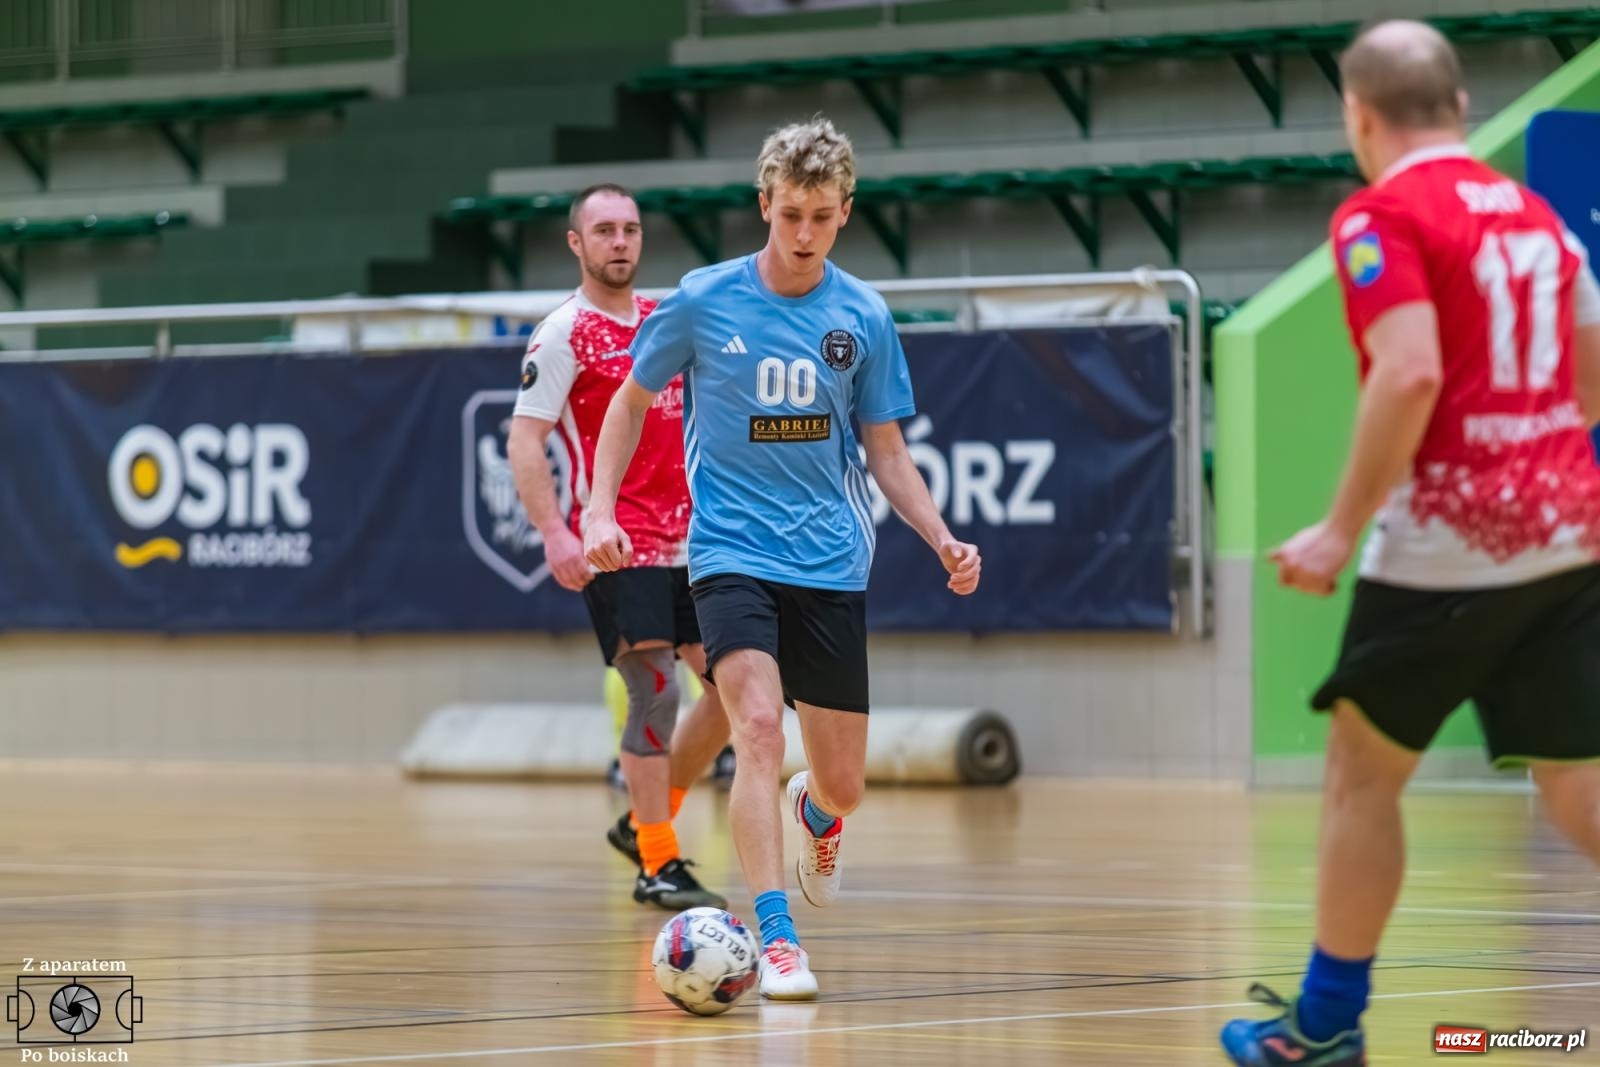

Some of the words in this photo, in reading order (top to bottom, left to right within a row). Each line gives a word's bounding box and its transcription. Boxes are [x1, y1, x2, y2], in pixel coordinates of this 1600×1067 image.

[1471, 229, 1561, 392] 17
[757, 357, 816, 407] 00
[753, 418, 829, 431] GABRIEL
[187, 523, 312, 567] RACIBÓRZ
[697, 923, 748, 962] SELECT
